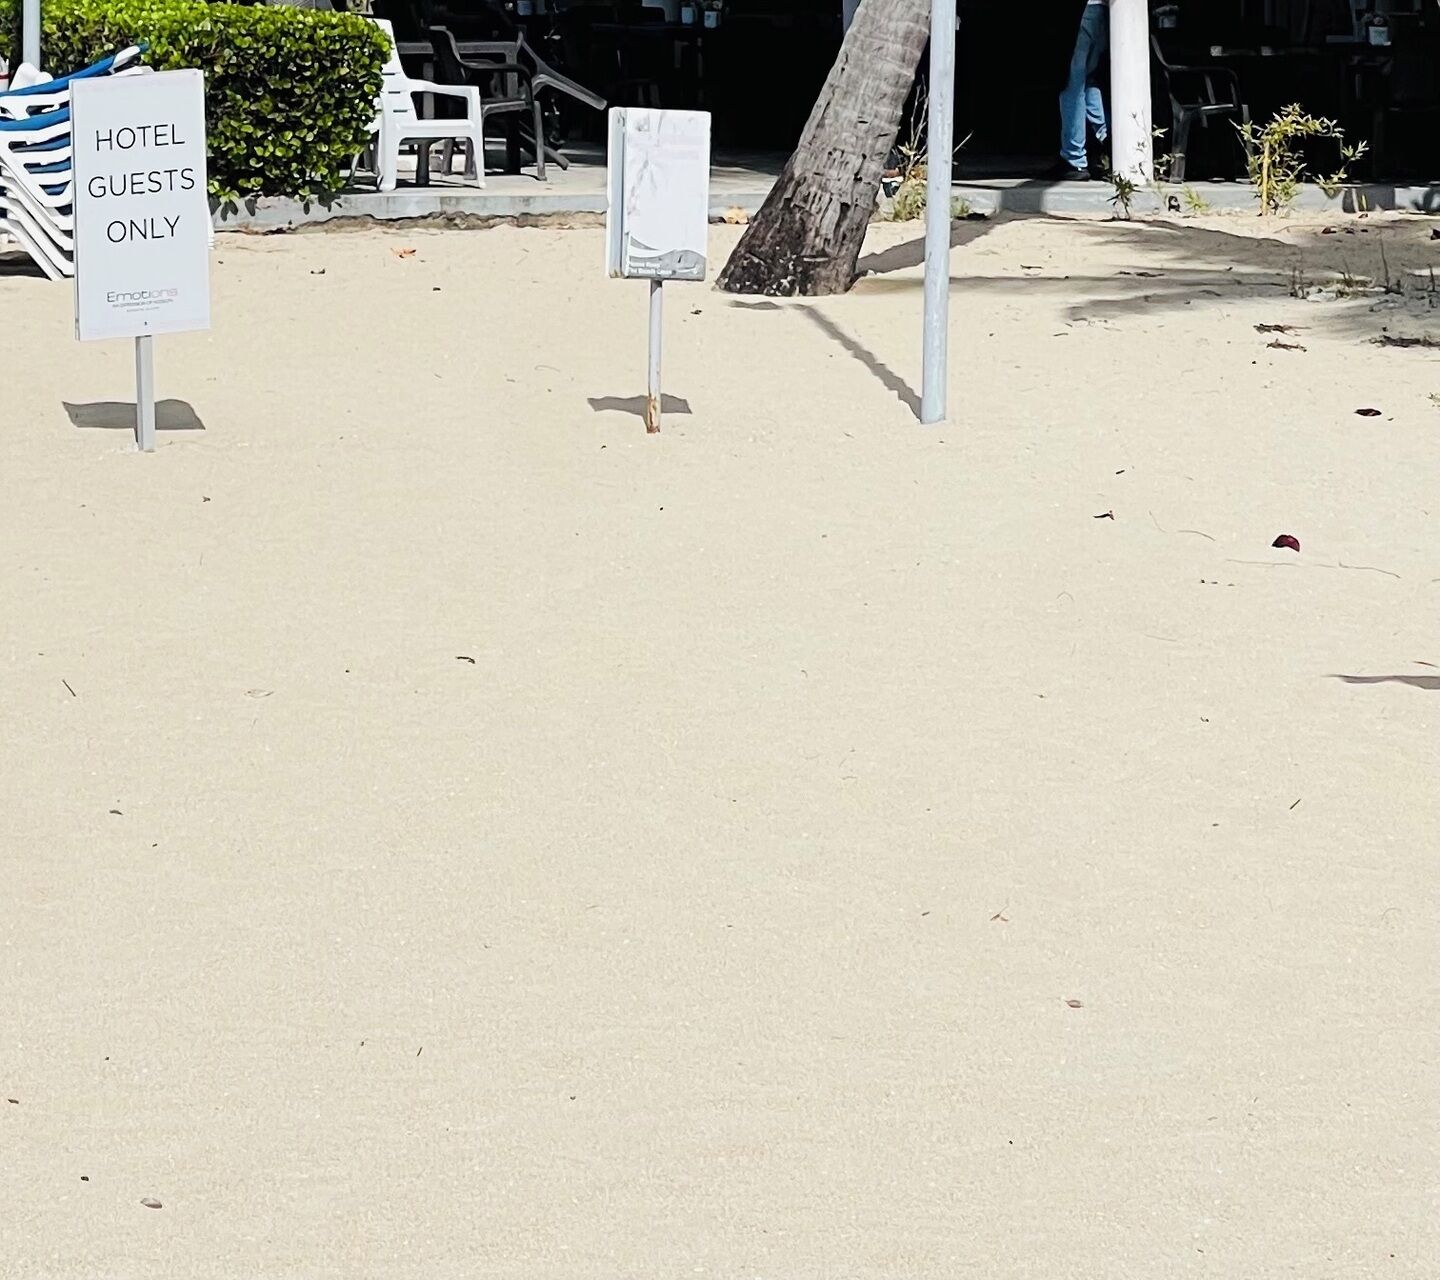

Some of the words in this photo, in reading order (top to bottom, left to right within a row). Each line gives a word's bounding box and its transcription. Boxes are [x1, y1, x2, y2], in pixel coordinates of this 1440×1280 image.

[95, 123, 186, 152] HOTEL
[88, 167, 195, 199] GUESTS
[107, 214, 181, 244] ONLY
[107, 288, 178, 303] Emotions
